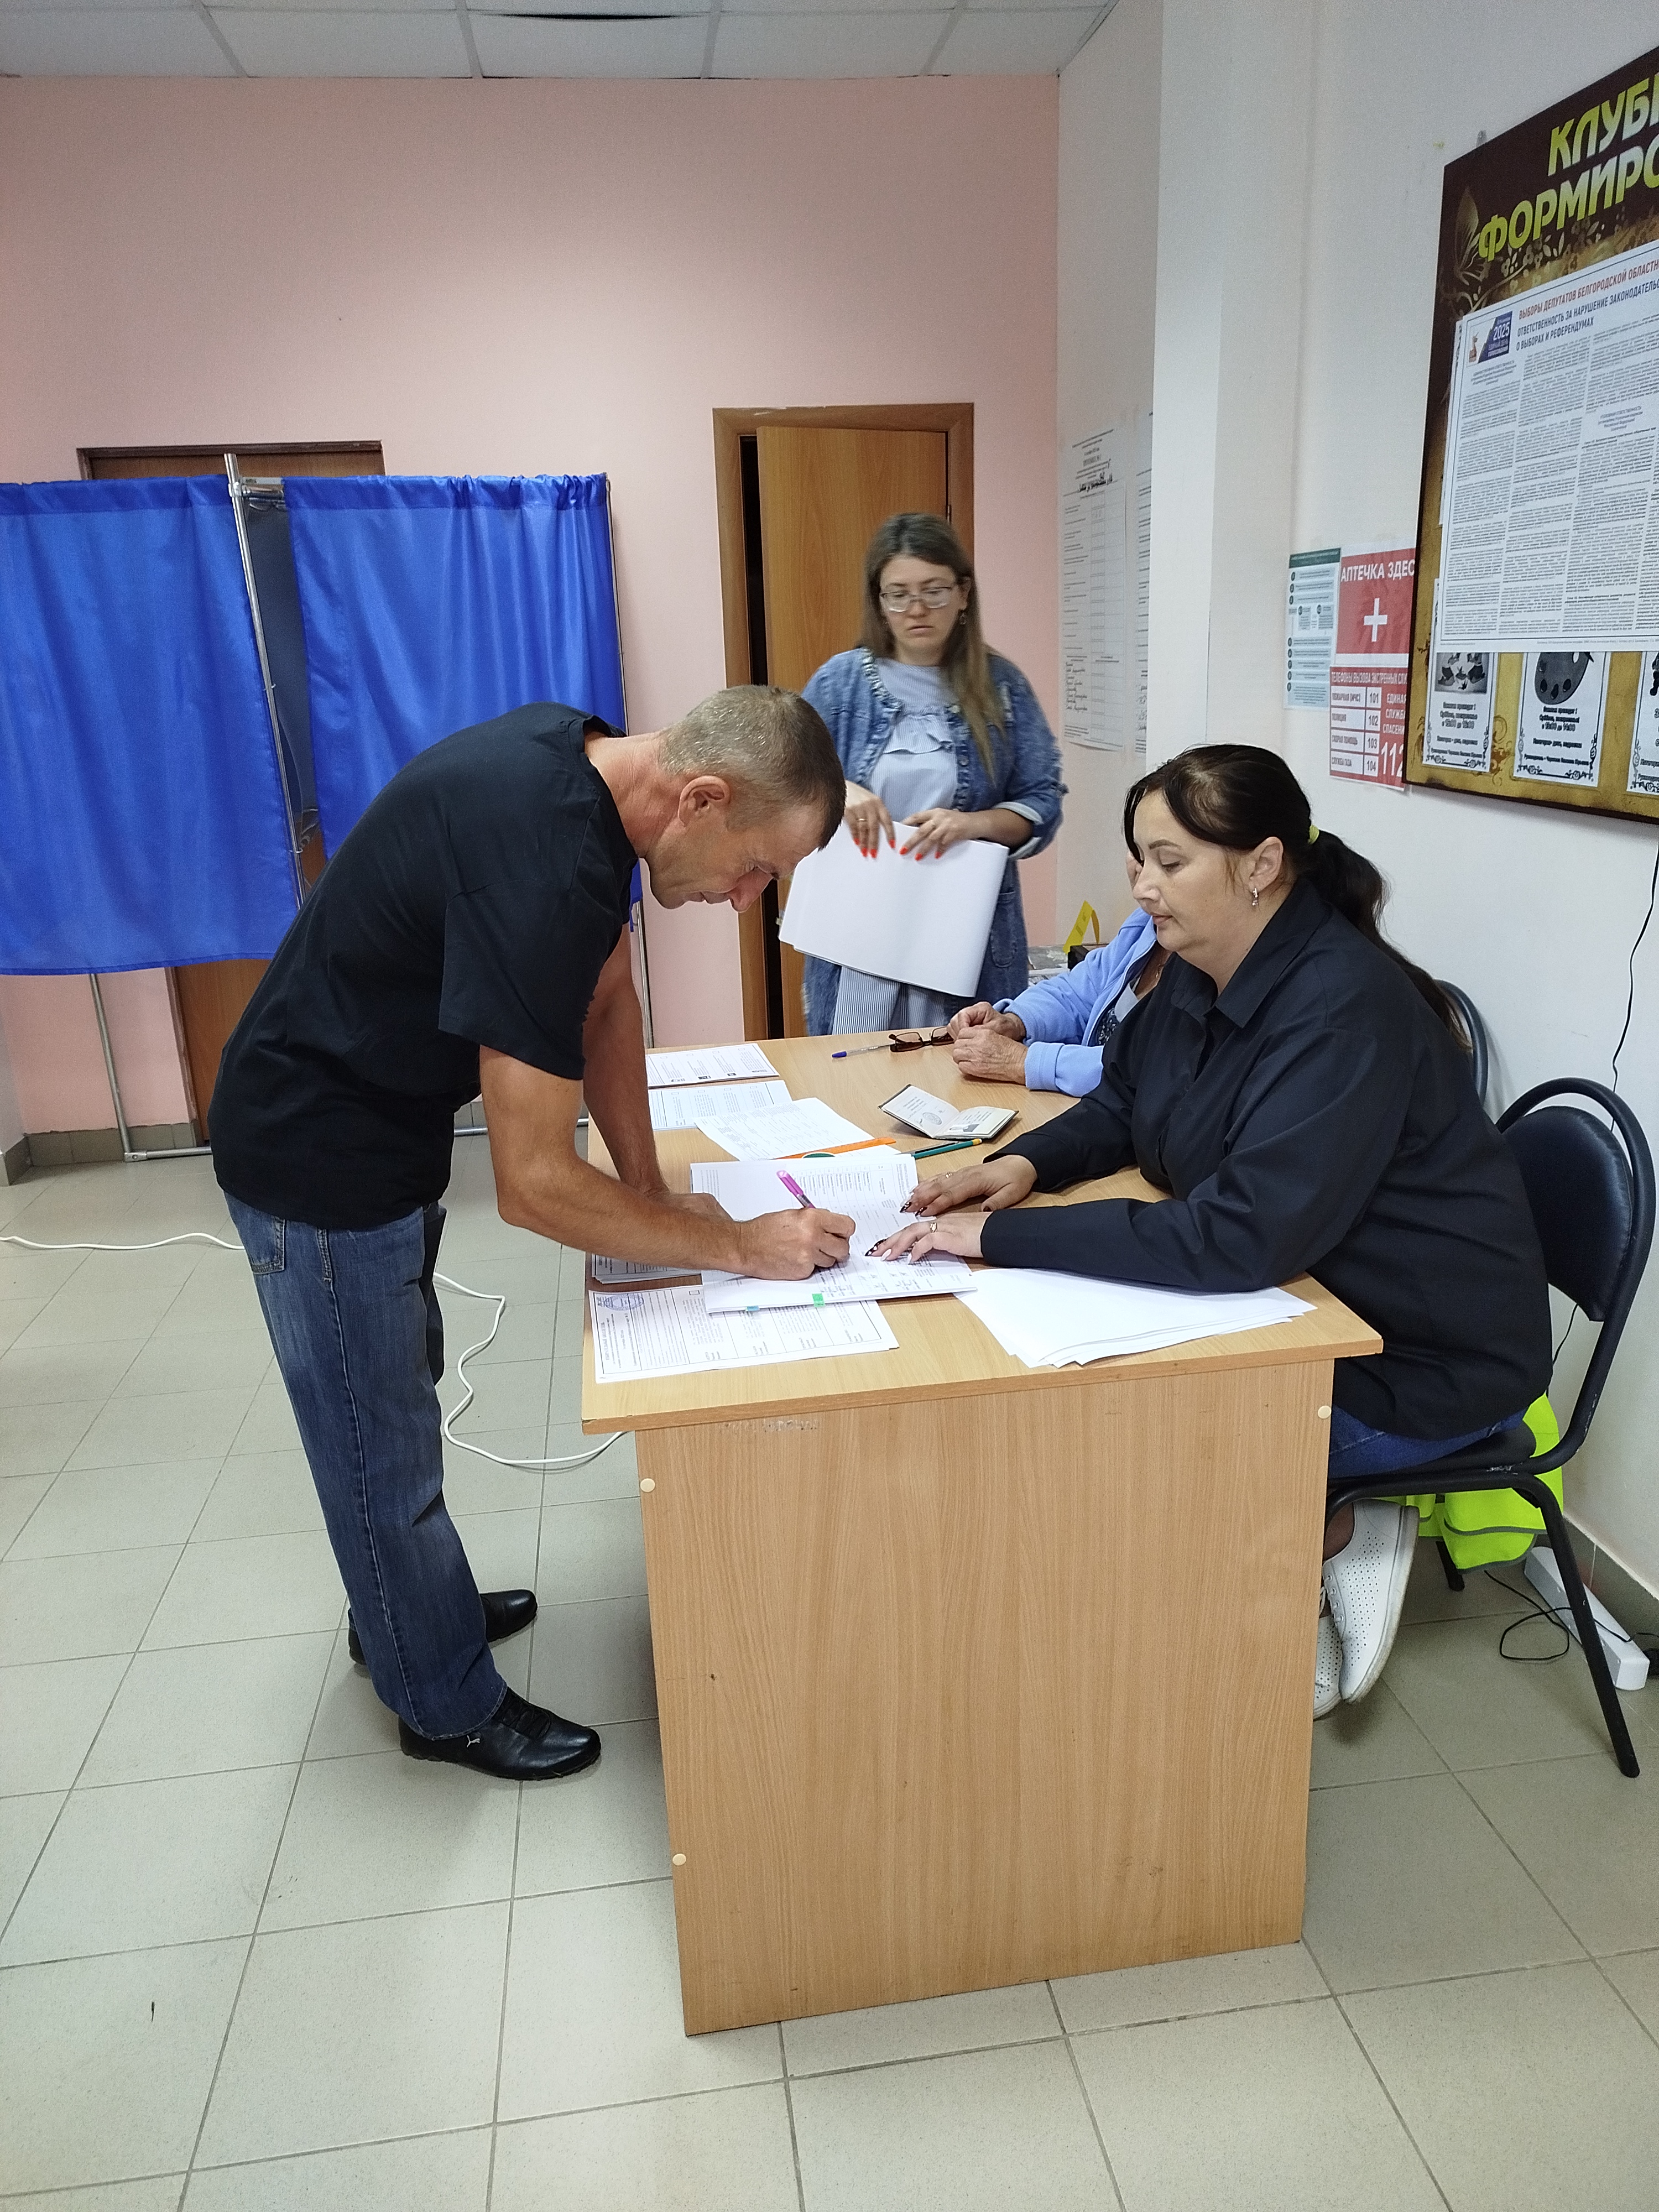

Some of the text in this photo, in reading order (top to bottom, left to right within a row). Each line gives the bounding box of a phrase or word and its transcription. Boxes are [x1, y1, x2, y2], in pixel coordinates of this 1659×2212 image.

[1519, 259, 1659, 320] ВЫБОРЫ ДЕПУТАТОВ БЕЛГОРОДСКОЙ ОБЛАСТН
[1517, 311, 1564, 337] ОТВЕТСТВЕННОСТЬ
[1565, 310, 1572, 320] ЗА
[1573, 296, 1609, 317] НАРУШЕНИЕ
[1493, 322, 1510, 341] 2025
[1516, 342, 1520, 351] О
[1521, 333, 1544, 350] ВЫБОРАХ
[1545, 332, 1550, 341] И
[1550, 316, 1594, 340] РЕФЕРЕНДУМАХ
[1341, 563, 1385, 582] АПТЕЧКА
[1331, 672, 1353, 682] ТЕЛЕФОНЫ
[1353, 672, 1371, 684] ВЫЗОВА
[1369, 693, 1379, 703] 101
[1369, 715, 1378, 726] 102
[1368, 738, 1378, 749] 103
[1366, 760, 1376, 771] 104
